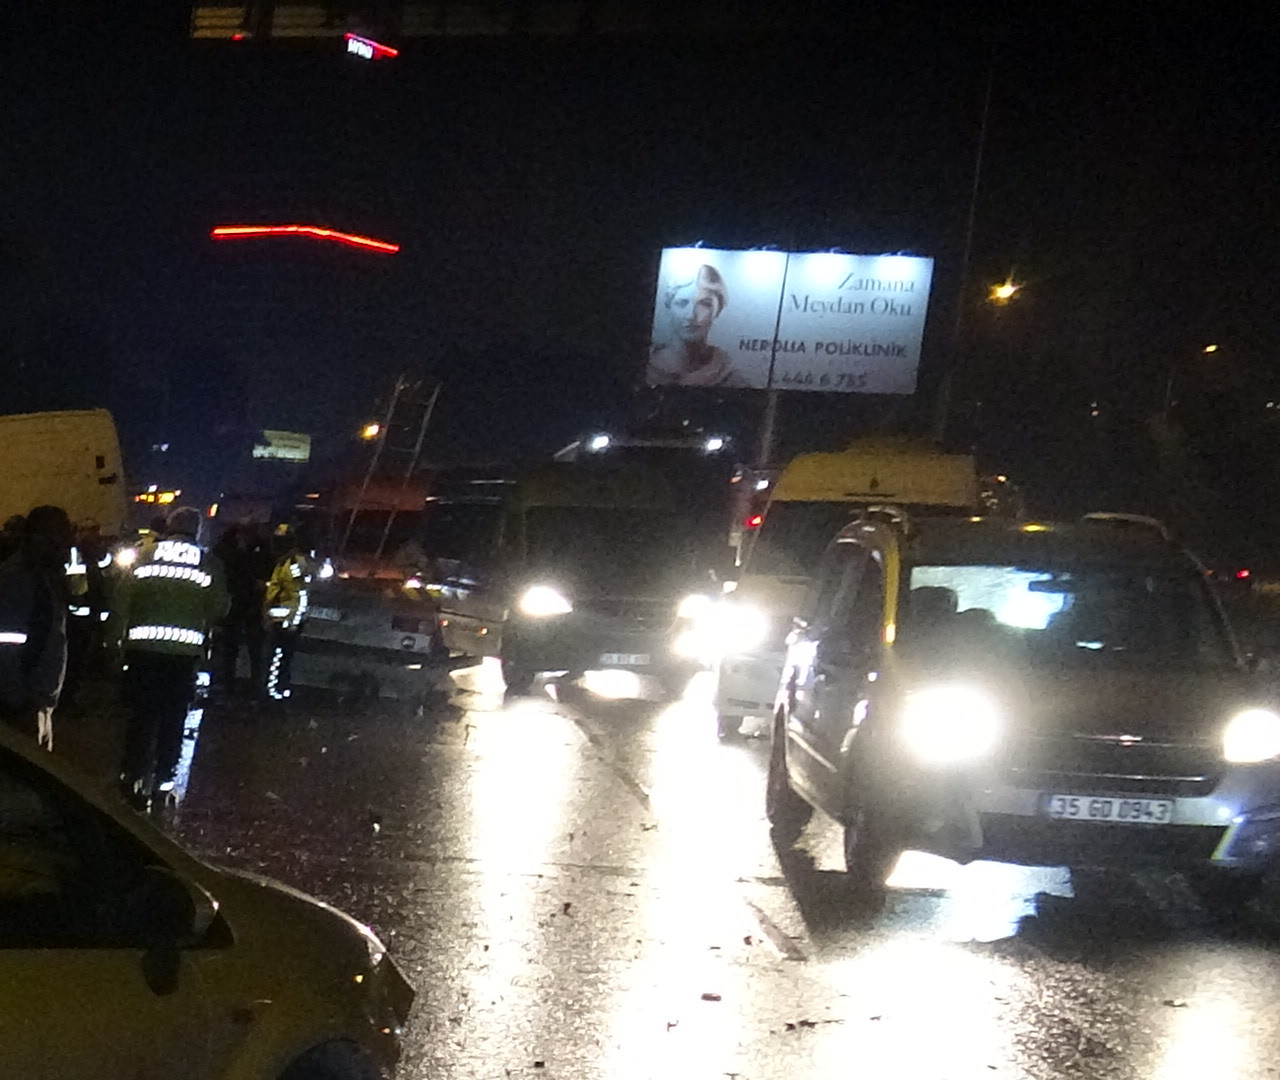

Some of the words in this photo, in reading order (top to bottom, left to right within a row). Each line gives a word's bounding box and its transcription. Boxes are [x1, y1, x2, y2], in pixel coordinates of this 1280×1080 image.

[789, 294, 865, 319] Meydan
[870, 299, 912, 316] Oku
[1054, 797, 1080, 816] 35
